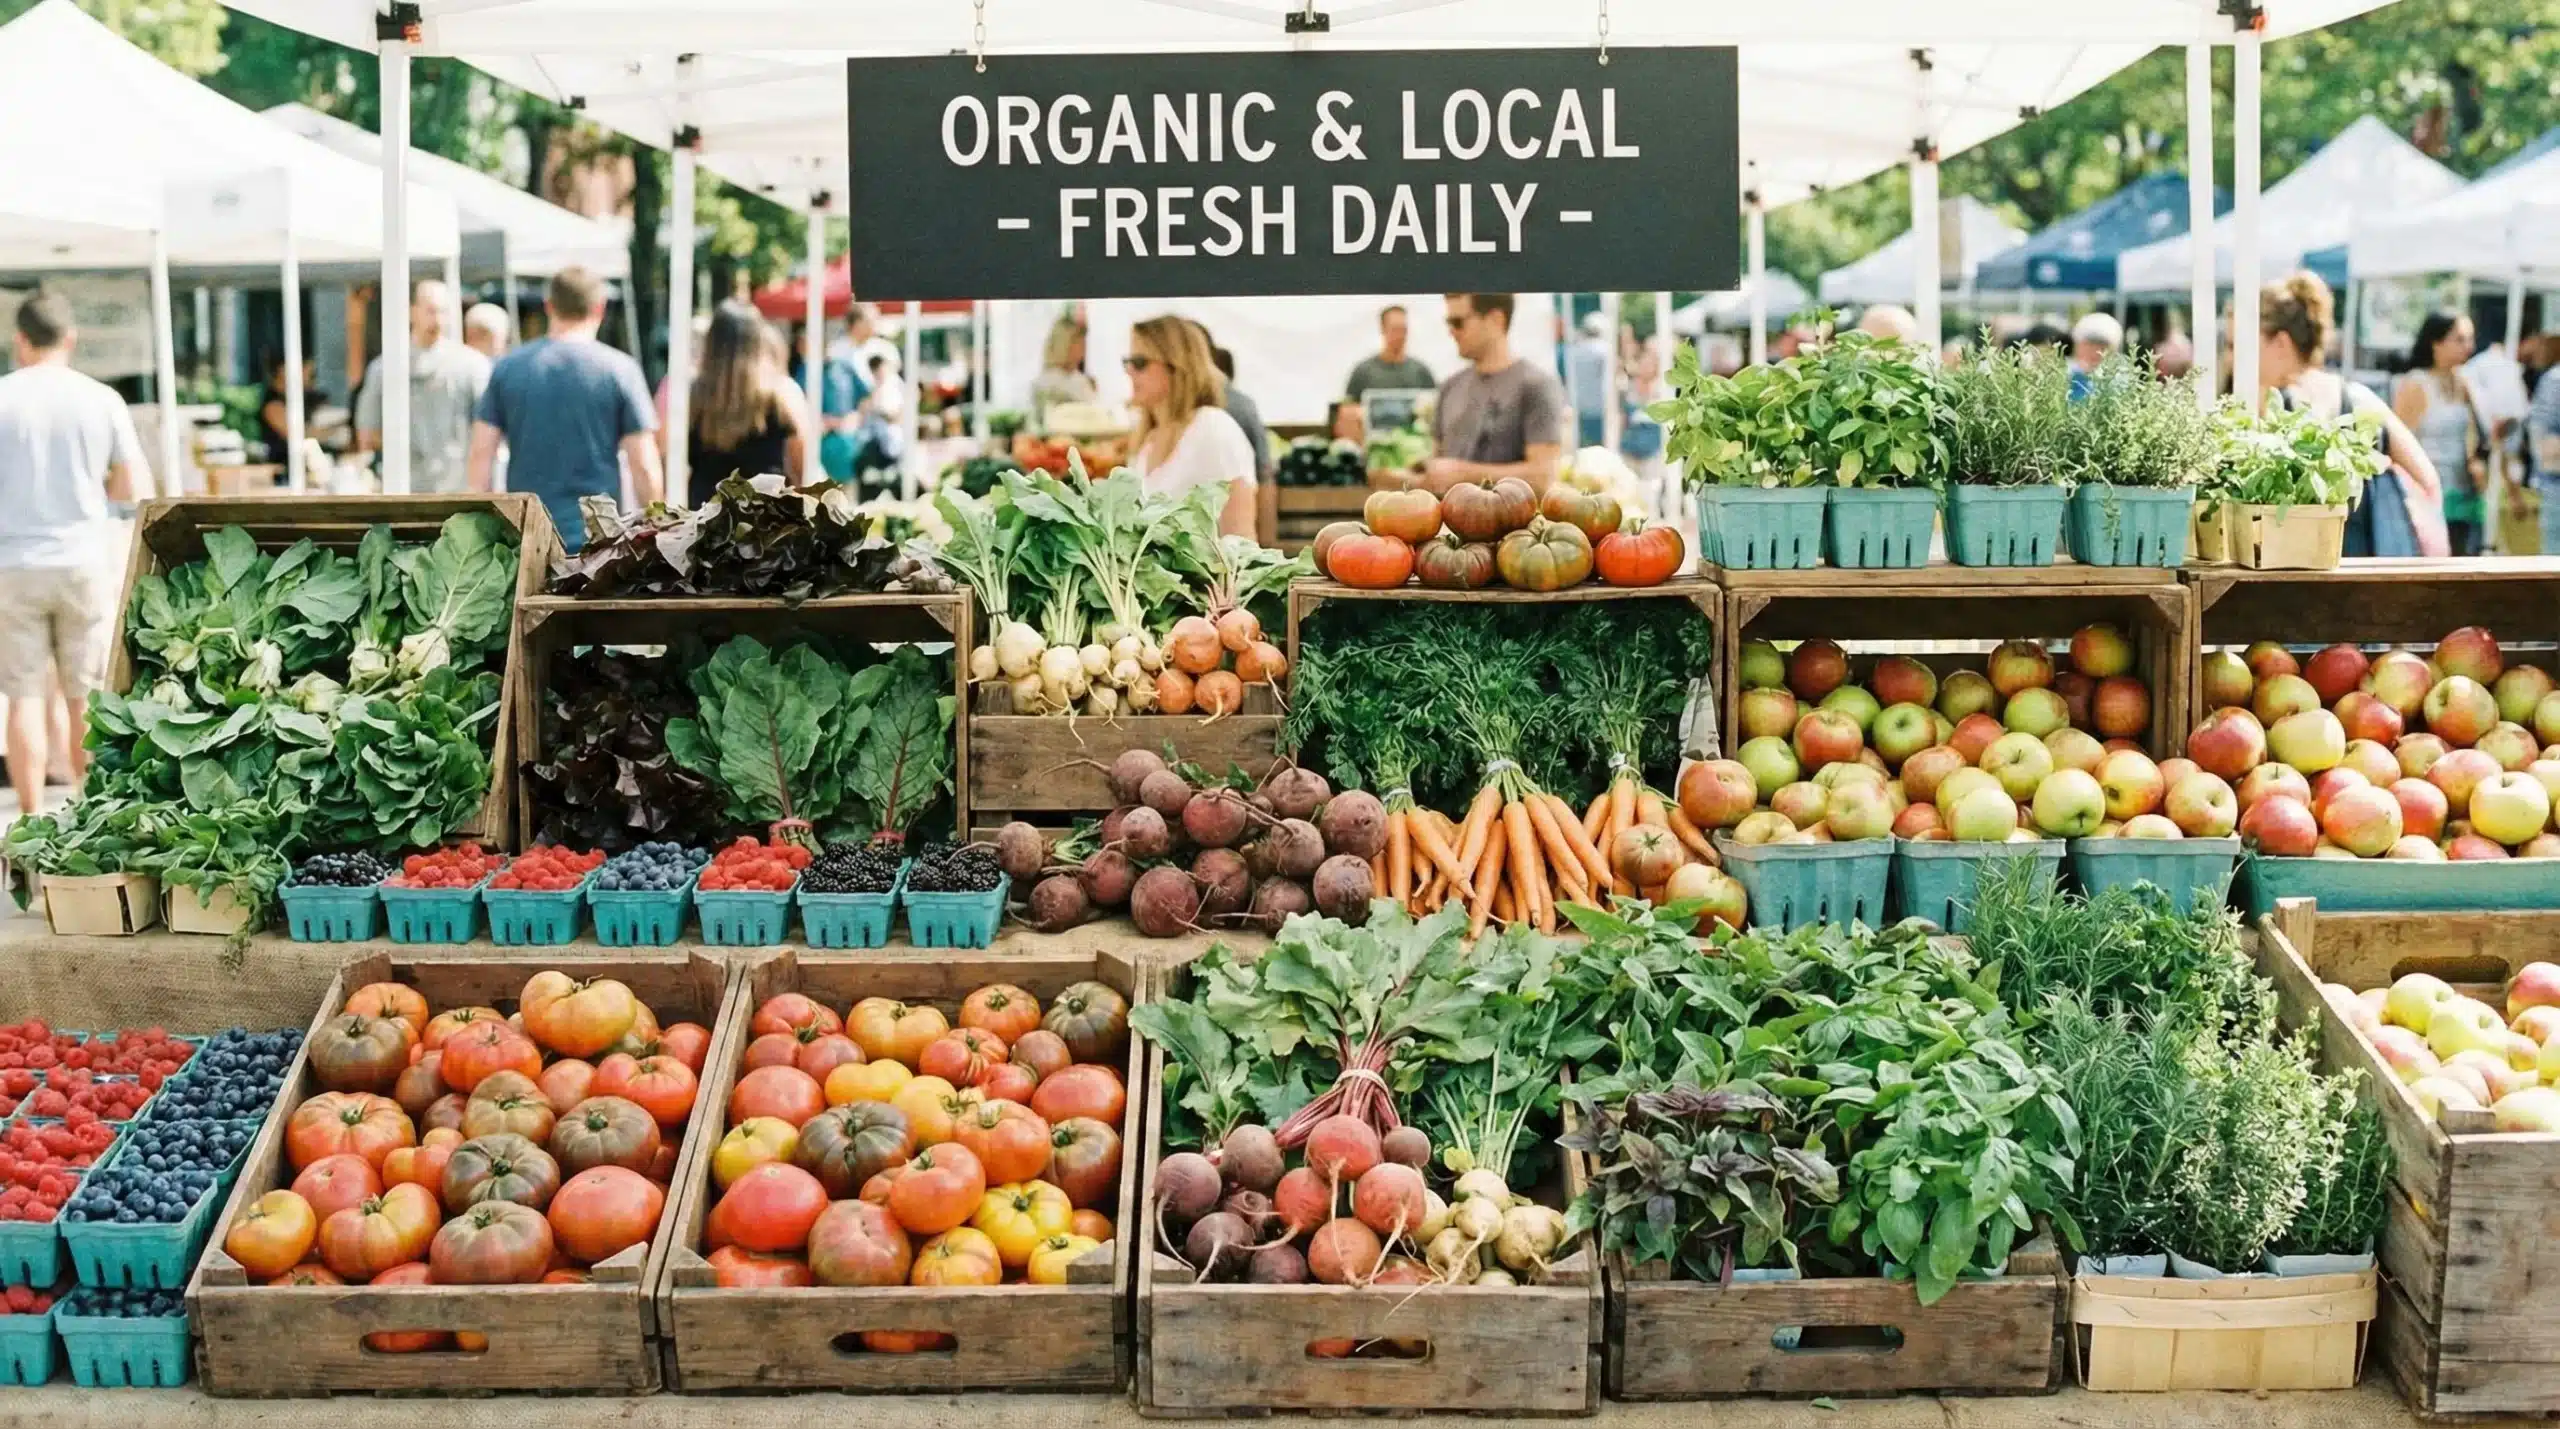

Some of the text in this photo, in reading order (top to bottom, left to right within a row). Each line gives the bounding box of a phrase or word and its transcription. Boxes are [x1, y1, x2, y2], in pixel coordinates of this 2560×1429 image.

[940, 86, 1641, 168] ORGANIC & LOCAL
[1058, 184, 1297, 259] FRESH
[1331, 181, 1540, 255] DAILY
